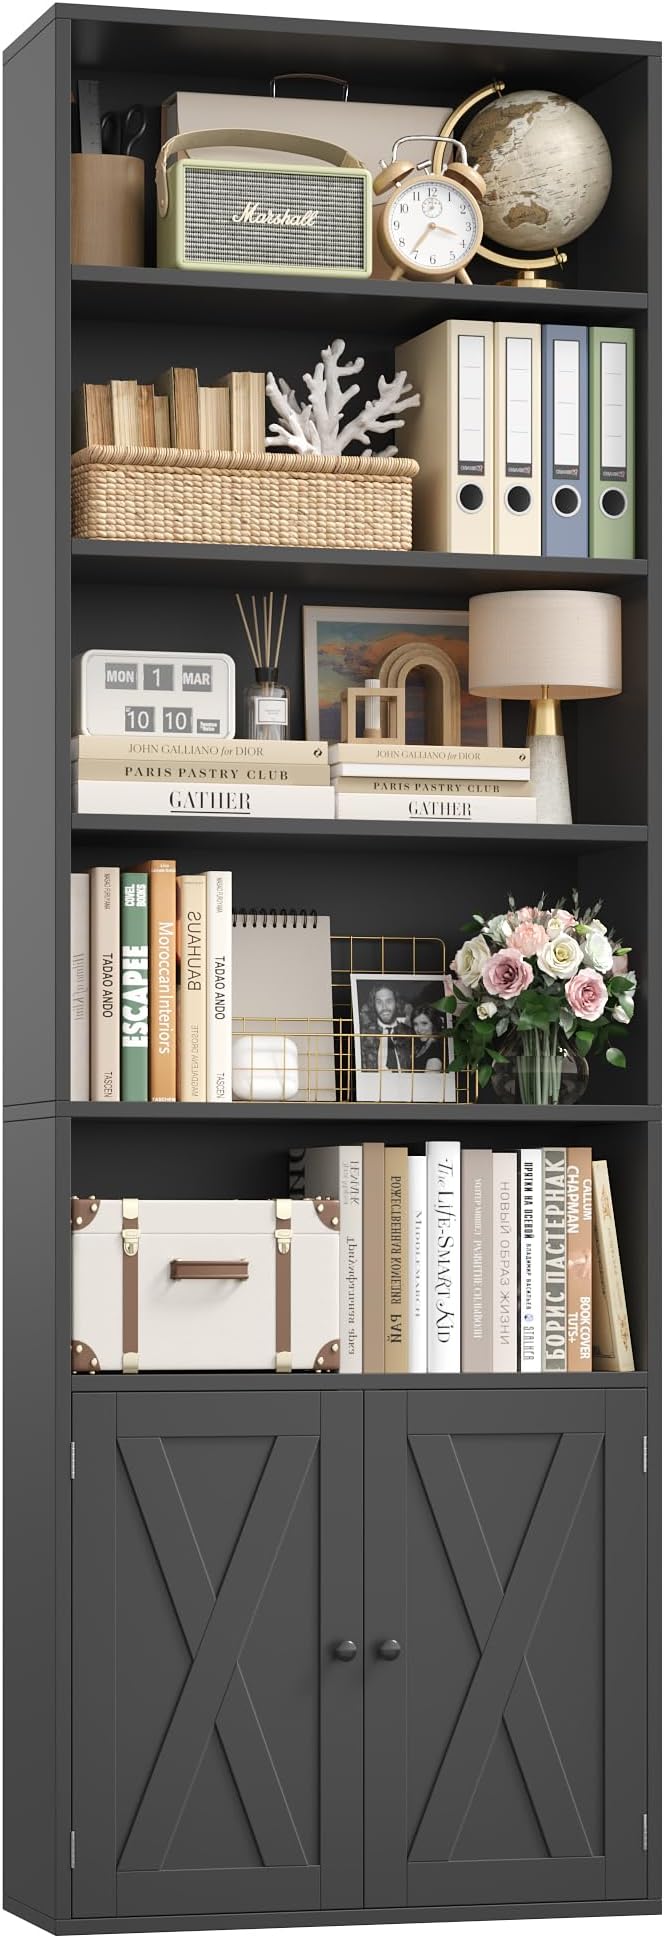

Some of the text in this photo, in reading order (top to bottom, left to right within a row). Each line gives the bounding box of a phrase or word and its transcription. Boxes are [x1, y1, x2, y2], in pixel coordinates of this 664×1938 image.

[413, 191, 420, 200] 11
[428, 187, 437, 197] 12
[232, 202, 318, 226] Marshall
[400, 204, 408, 213] 10
[460, 205, 466, 214] 2
[394, 220, 399, 230] 9
[466, 222, 471, 232] 3
[399, 237, 405, 247] 8
[459, 240, 466, 248] 4
[413, 250, 418, 260] 7
[430, 255, 436, 264] 6
[450, 251, 455, 260] 5
[106, 671, 134, 683] MON
[153, 669, 160, 687] 1
[182, 672, 210, 685] MAR
[128, 711, 149, 728] 10
[165, 712, 187, 730] 10
[128, 744, 264, 756] JOHN GALLIANO for DIOR
[376, 750, 400, 759] JOHN
[401, 751, 446, 760] GALLIANO
[447, 752, 457, 761] for
[125, 766, 289, 780] PARIS PASTRY CLUB
[373, 782, 500, 793] PARIS PASTRY CLUB
[169, 791, 250, 809] GATHER
[408, 801, 471, 816] GATHER
[136, 884, 146, 907] BOOKS
[103, 953, 113, 1018] TADAO ANDO
[158, 922, 173, 1054] Moroccan Interiors
[215, 956, 225, 1020] TADAO ANDO
[122, 946, 148, 1047] ESCAPEE
[437, 1162, 453, 1187] The
[524, 1162, 534, 1238] ПРЯТКИ НА ОСЕВОЙ
[567, 1165, 579, 1233] CHAPMAN
[583, 1179, 592, 1220] CALLUM
[500, 1182, 512, 1345] НОВЫЙ ОБРАЗ ЖИЗНИ
[545, 1158, 565, 1360] БОРИС ПАСТЕРНАК
[568, 1312, 579, 1343] TUTS+
[580, 1296, 591, 1359] BOOK COVER
